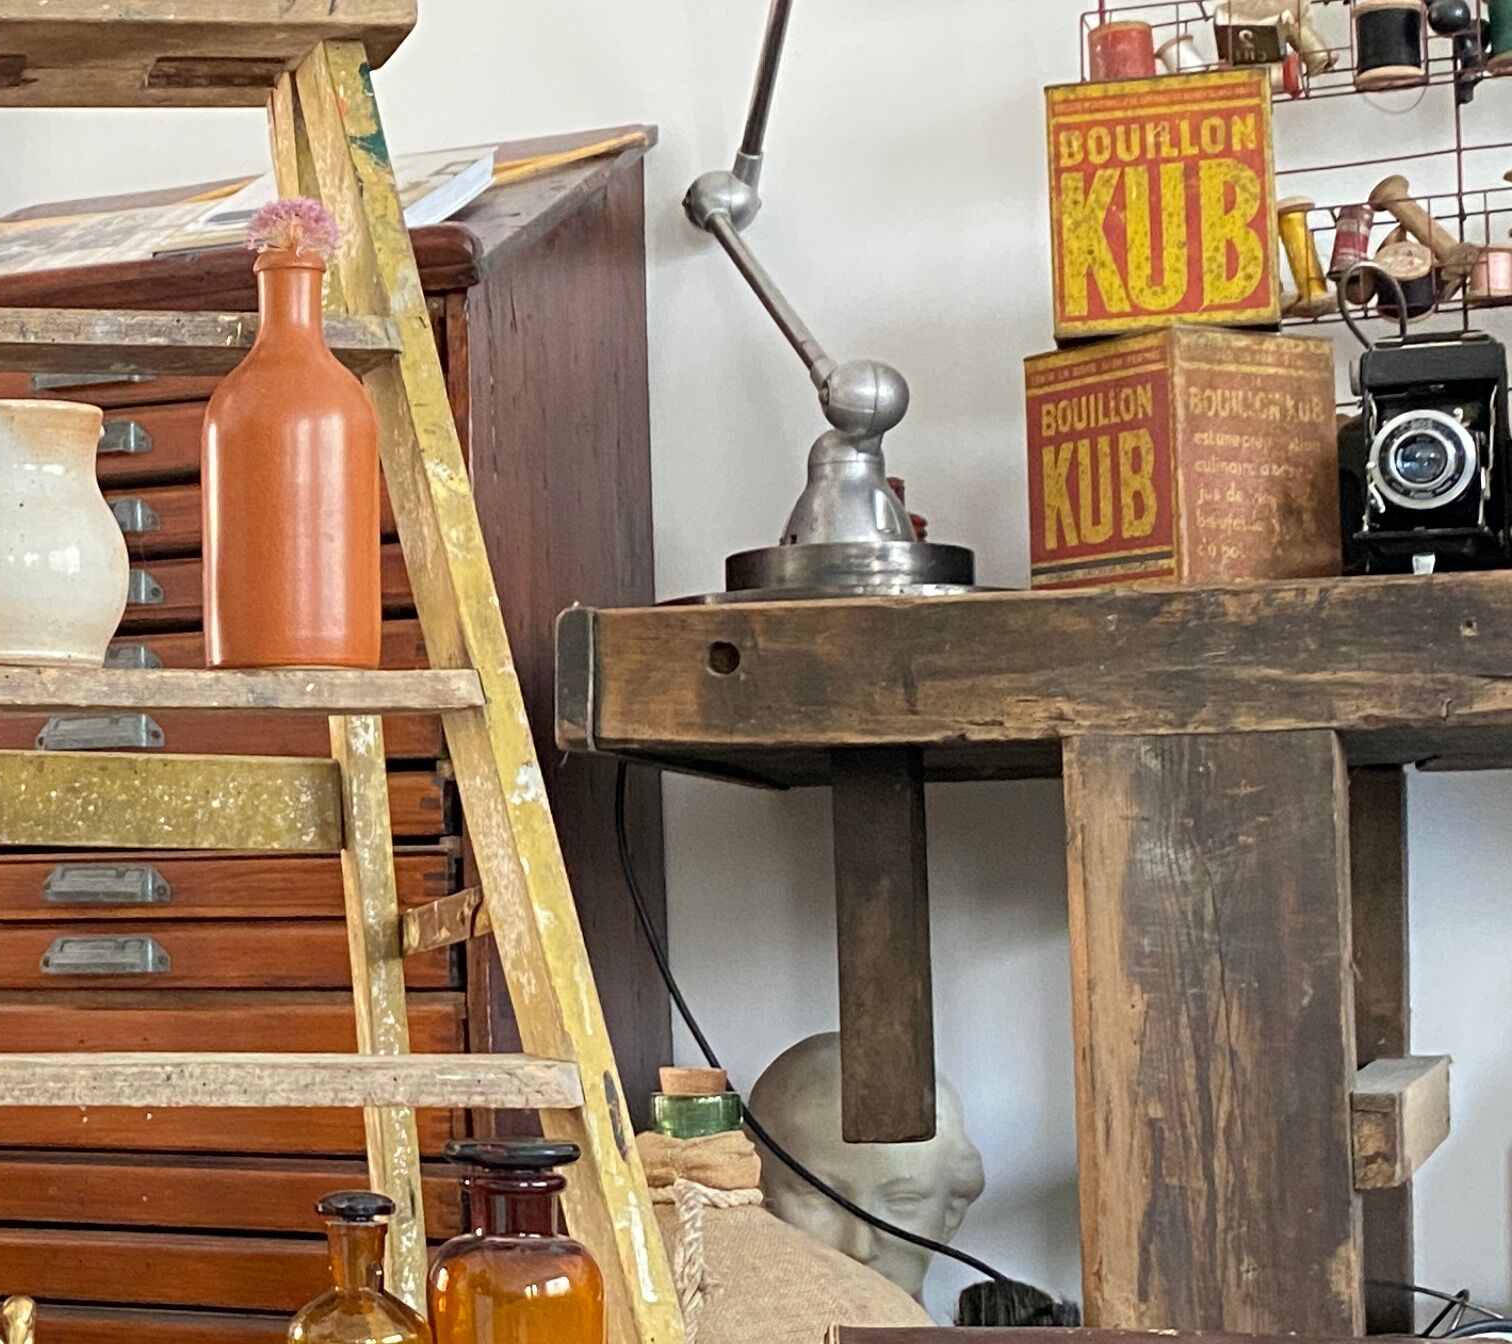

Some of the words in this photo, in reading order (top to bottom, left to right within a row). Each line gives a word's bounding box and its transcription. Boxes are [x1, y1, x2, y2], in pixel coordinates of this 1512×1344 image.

[1059, 113, 1257, 167] BOUILLON
[1060, 158, 1264, 316] KUB
[1041, 383, 1153, 437] BOUILLON
[1042, 428, 1157, 550] KUB
